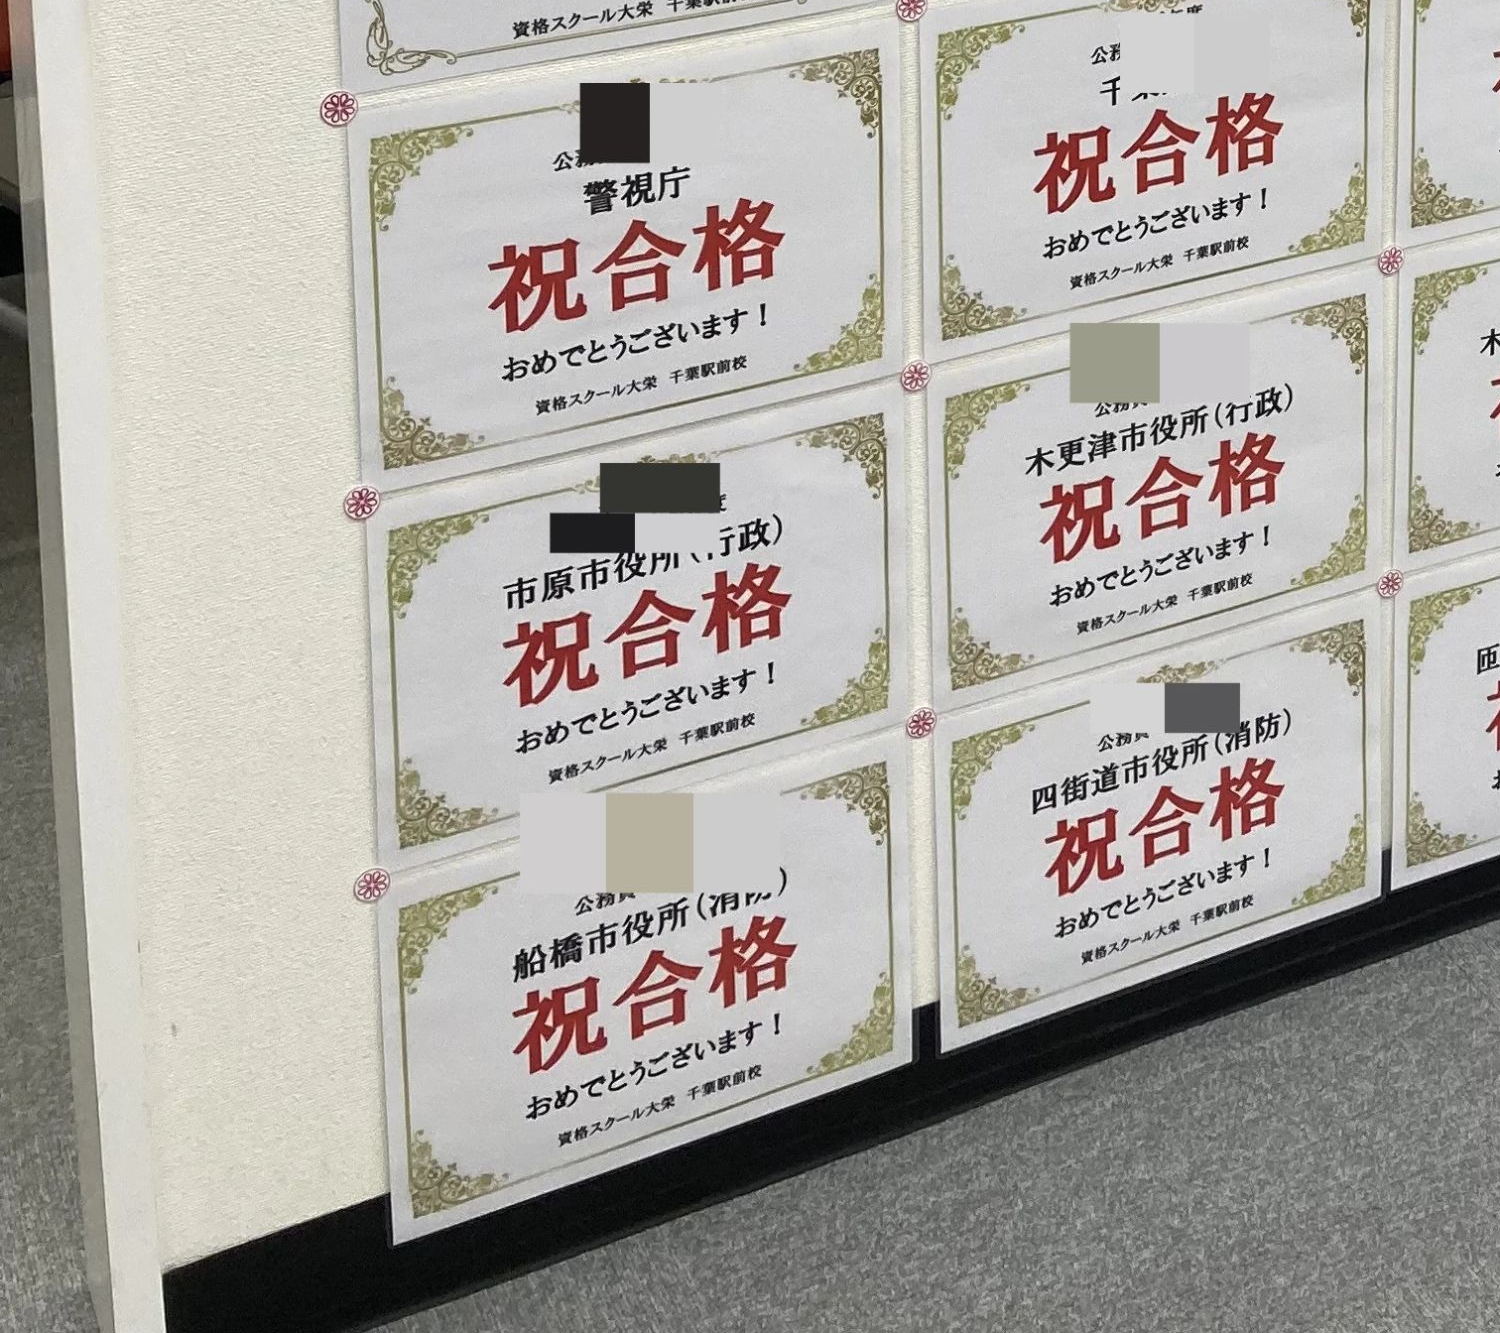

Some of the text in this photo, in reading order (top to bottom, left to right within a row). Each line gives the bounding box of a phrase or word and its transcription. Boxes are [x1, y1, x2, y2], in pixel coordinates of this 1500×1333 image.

[512, 0, 654, 40] 資格スクール大栄
[583, 165, 691, 215] 警視庁
[1033, 93, 1284, 215] 祝合格
[502, 562, 792, 708] 祝合格
[1076, 572, 1254, 635] 資格スクール大栄 千葉駅前校
[1044, 757, 1285, 897] 祝合格
